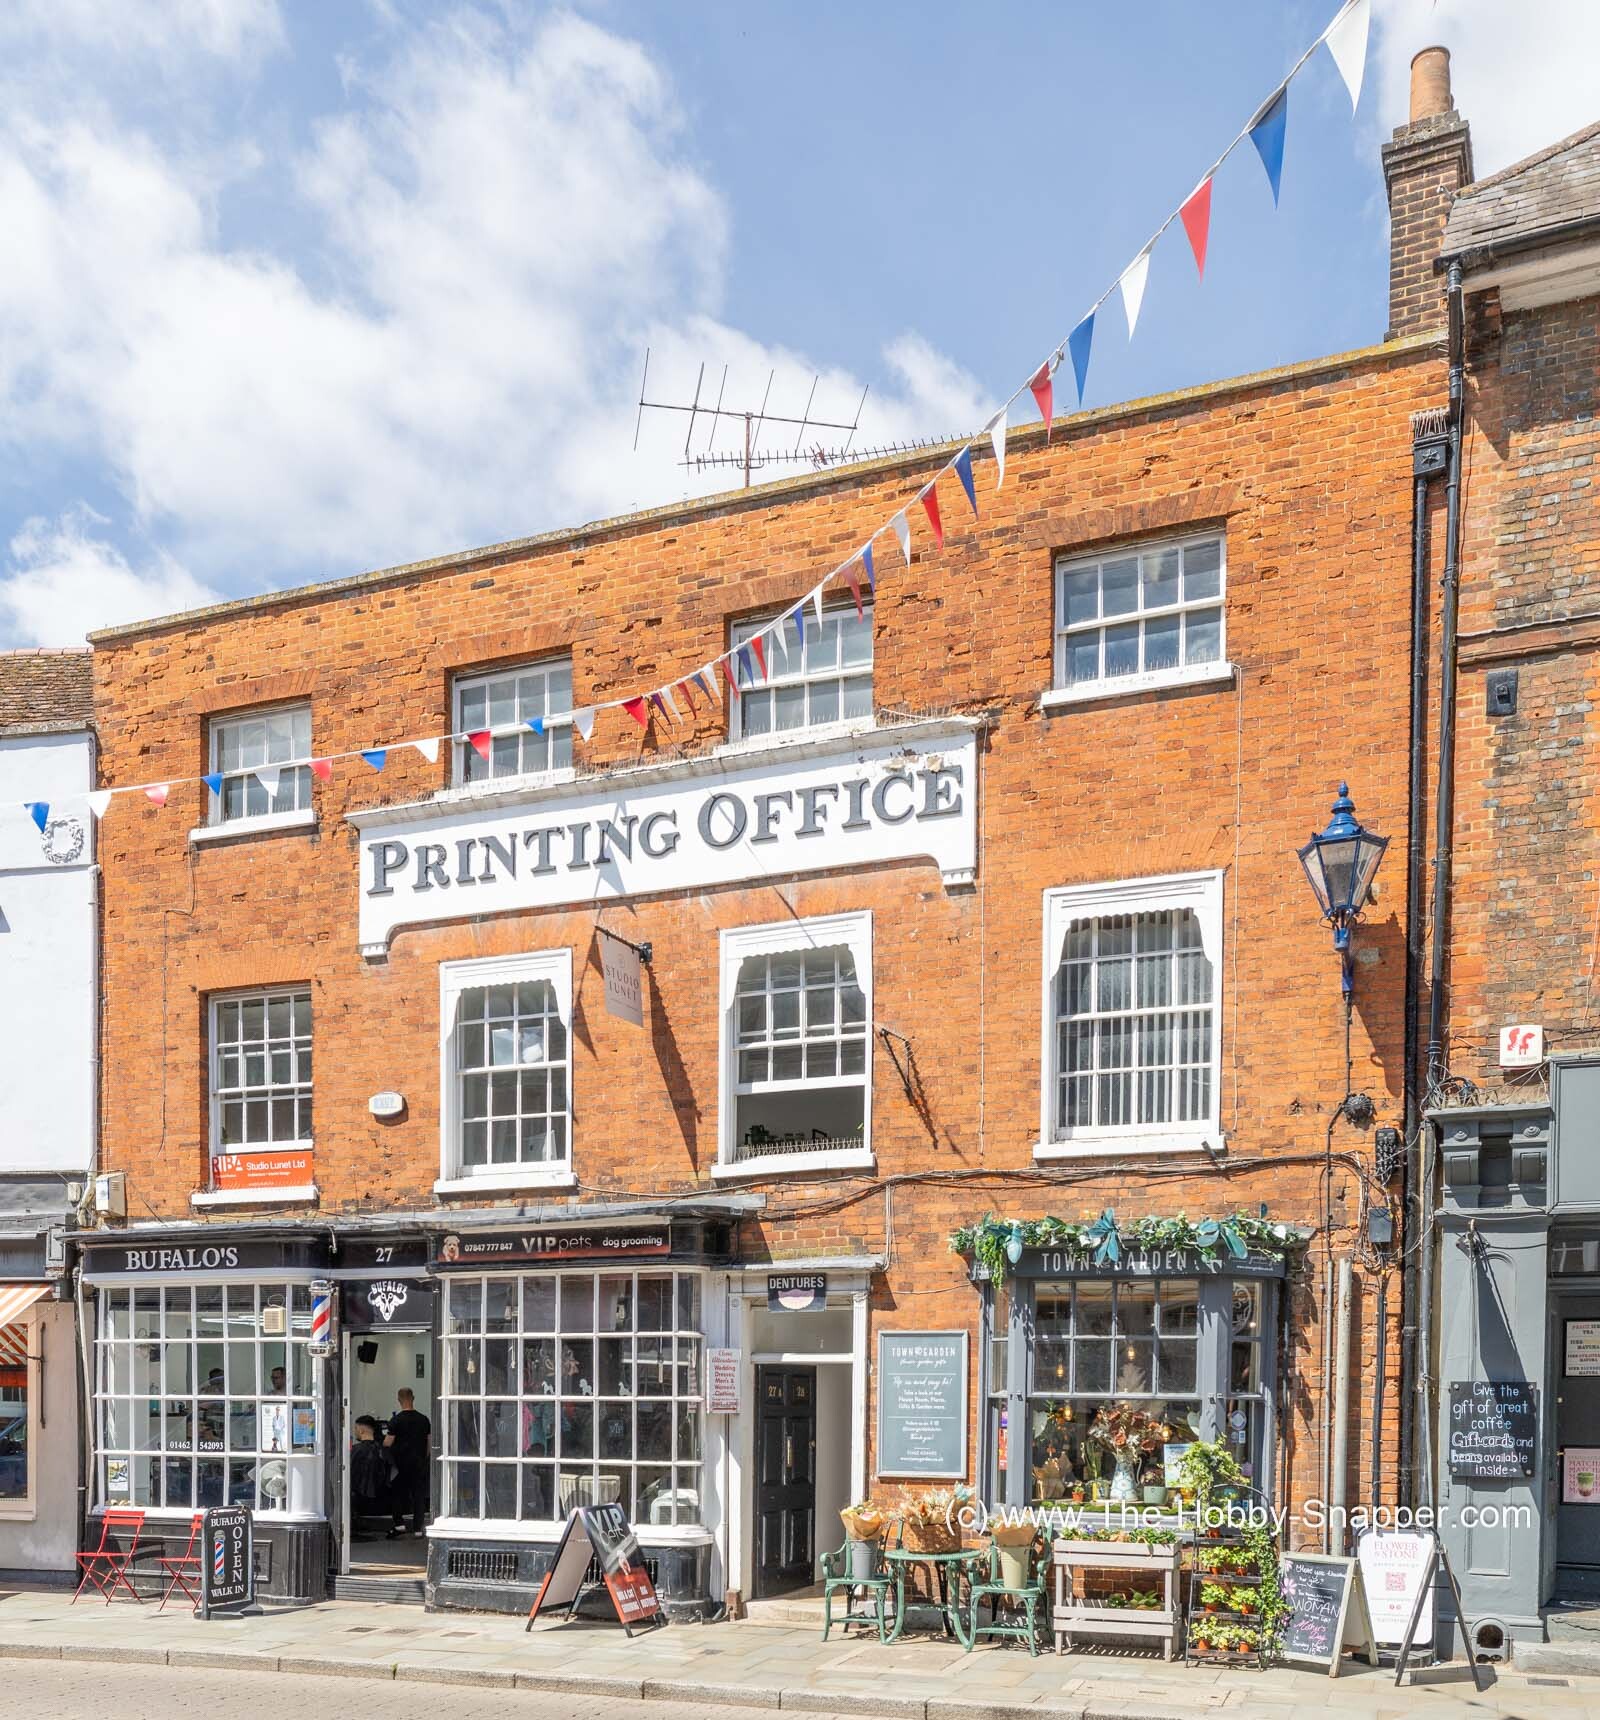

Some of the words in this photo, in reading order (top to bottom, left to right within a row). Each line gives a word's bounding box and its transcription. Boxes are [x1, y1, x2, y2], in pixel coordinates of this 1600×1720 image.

[366, 811, 682, 897] PRINTING
[697, 765, 964, 850] OFFICE
[606, 964, 640, 990] STUDIO
[212, 1155, 244, 1173] RIBA
[246, 1161, 269, 1171] Studio
[270, 1160, 291, 1169] Lunet
[292, 1159, 306, 1168] Ltd
[464, 1243, 485, 1252] 07847
[486, 1243, 499, 1251] 777
[500, 1242, 513, 1251] 847
[521, 1236, 557, 1253] VIP
[558, 1235, 592, 1255] pets
[602, 1236, 619, 1248] dog
[620, 1235, 663, 1248] grooming
[125, 1247, 239, 1271] BUFALO'S
[375, 1247, 393, 1262] 27
[1042, 1252, 1090, 1272] TOWN
[769, 1276, 824, 1289] DENTURES
[892, 1347, 914, 1357] TOWN
[923, 1347, 956, 1357] GARDEN
[1473, 1382, 1495, 1396] Give
[1501, 1384, 1519, 1397] the
[1453, 1399, 1474, 1420] gift
[1477, 1399, 1492, 1414] of
[1495, 1400, 1528, 1419] great
[1471, 1416, 1512, 1430] coffee
[169, 1440, 191, 1449] 01462
[199, 1441, 224, 1450] 542093
[1516, 1436, 1534, 1448] and
[1483, 1451, 1528, 1463] available
[1475, 1464, 1509, 1476] inside
[210, 1515, 246, 1527] BUFALO'S
[588, 1507, 623, 1531] VIP
[1374, 1541, 1419, 1550] FLOWER
[232, 1526, 243, 1583] OPEN
[1382, 1550, 1417, 1559] STONE
[210, 1586, 234, 1598] WALK
[234, 1584, 244, 1593] IN
[1291, 1596, 1341, 1618] WOMAN
